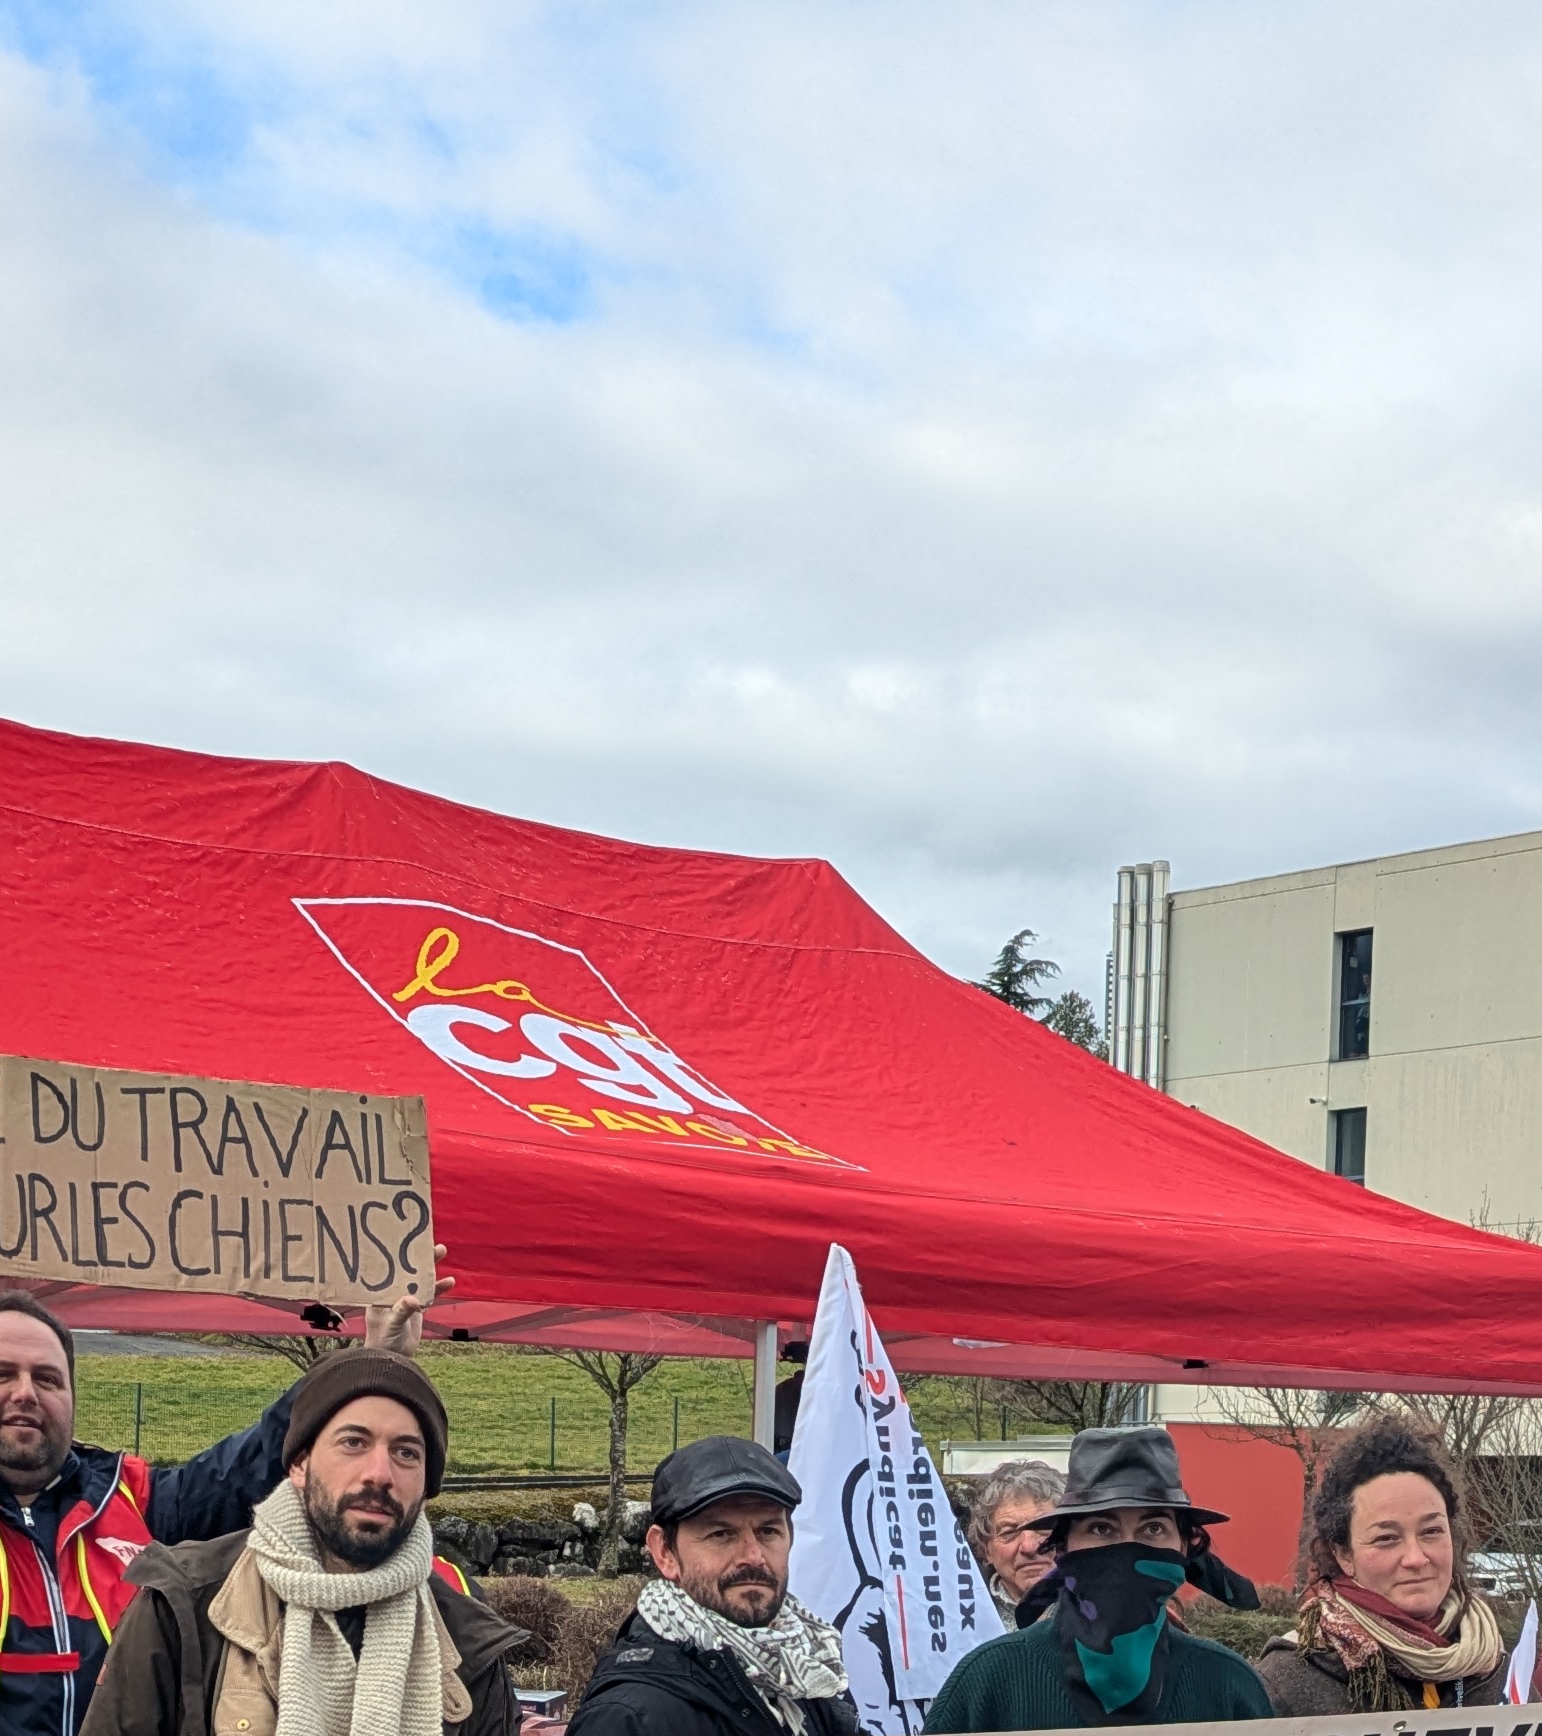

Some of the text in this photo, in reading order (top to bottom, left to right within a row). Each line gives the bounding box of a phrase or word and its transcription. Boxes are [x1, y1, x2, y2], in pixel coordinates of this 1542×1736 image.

[32, 1071, 104, 1151] DU
[121, 1086, 413, 1186] TRAVAIL
[69, 1180, 156, 1269] LES
